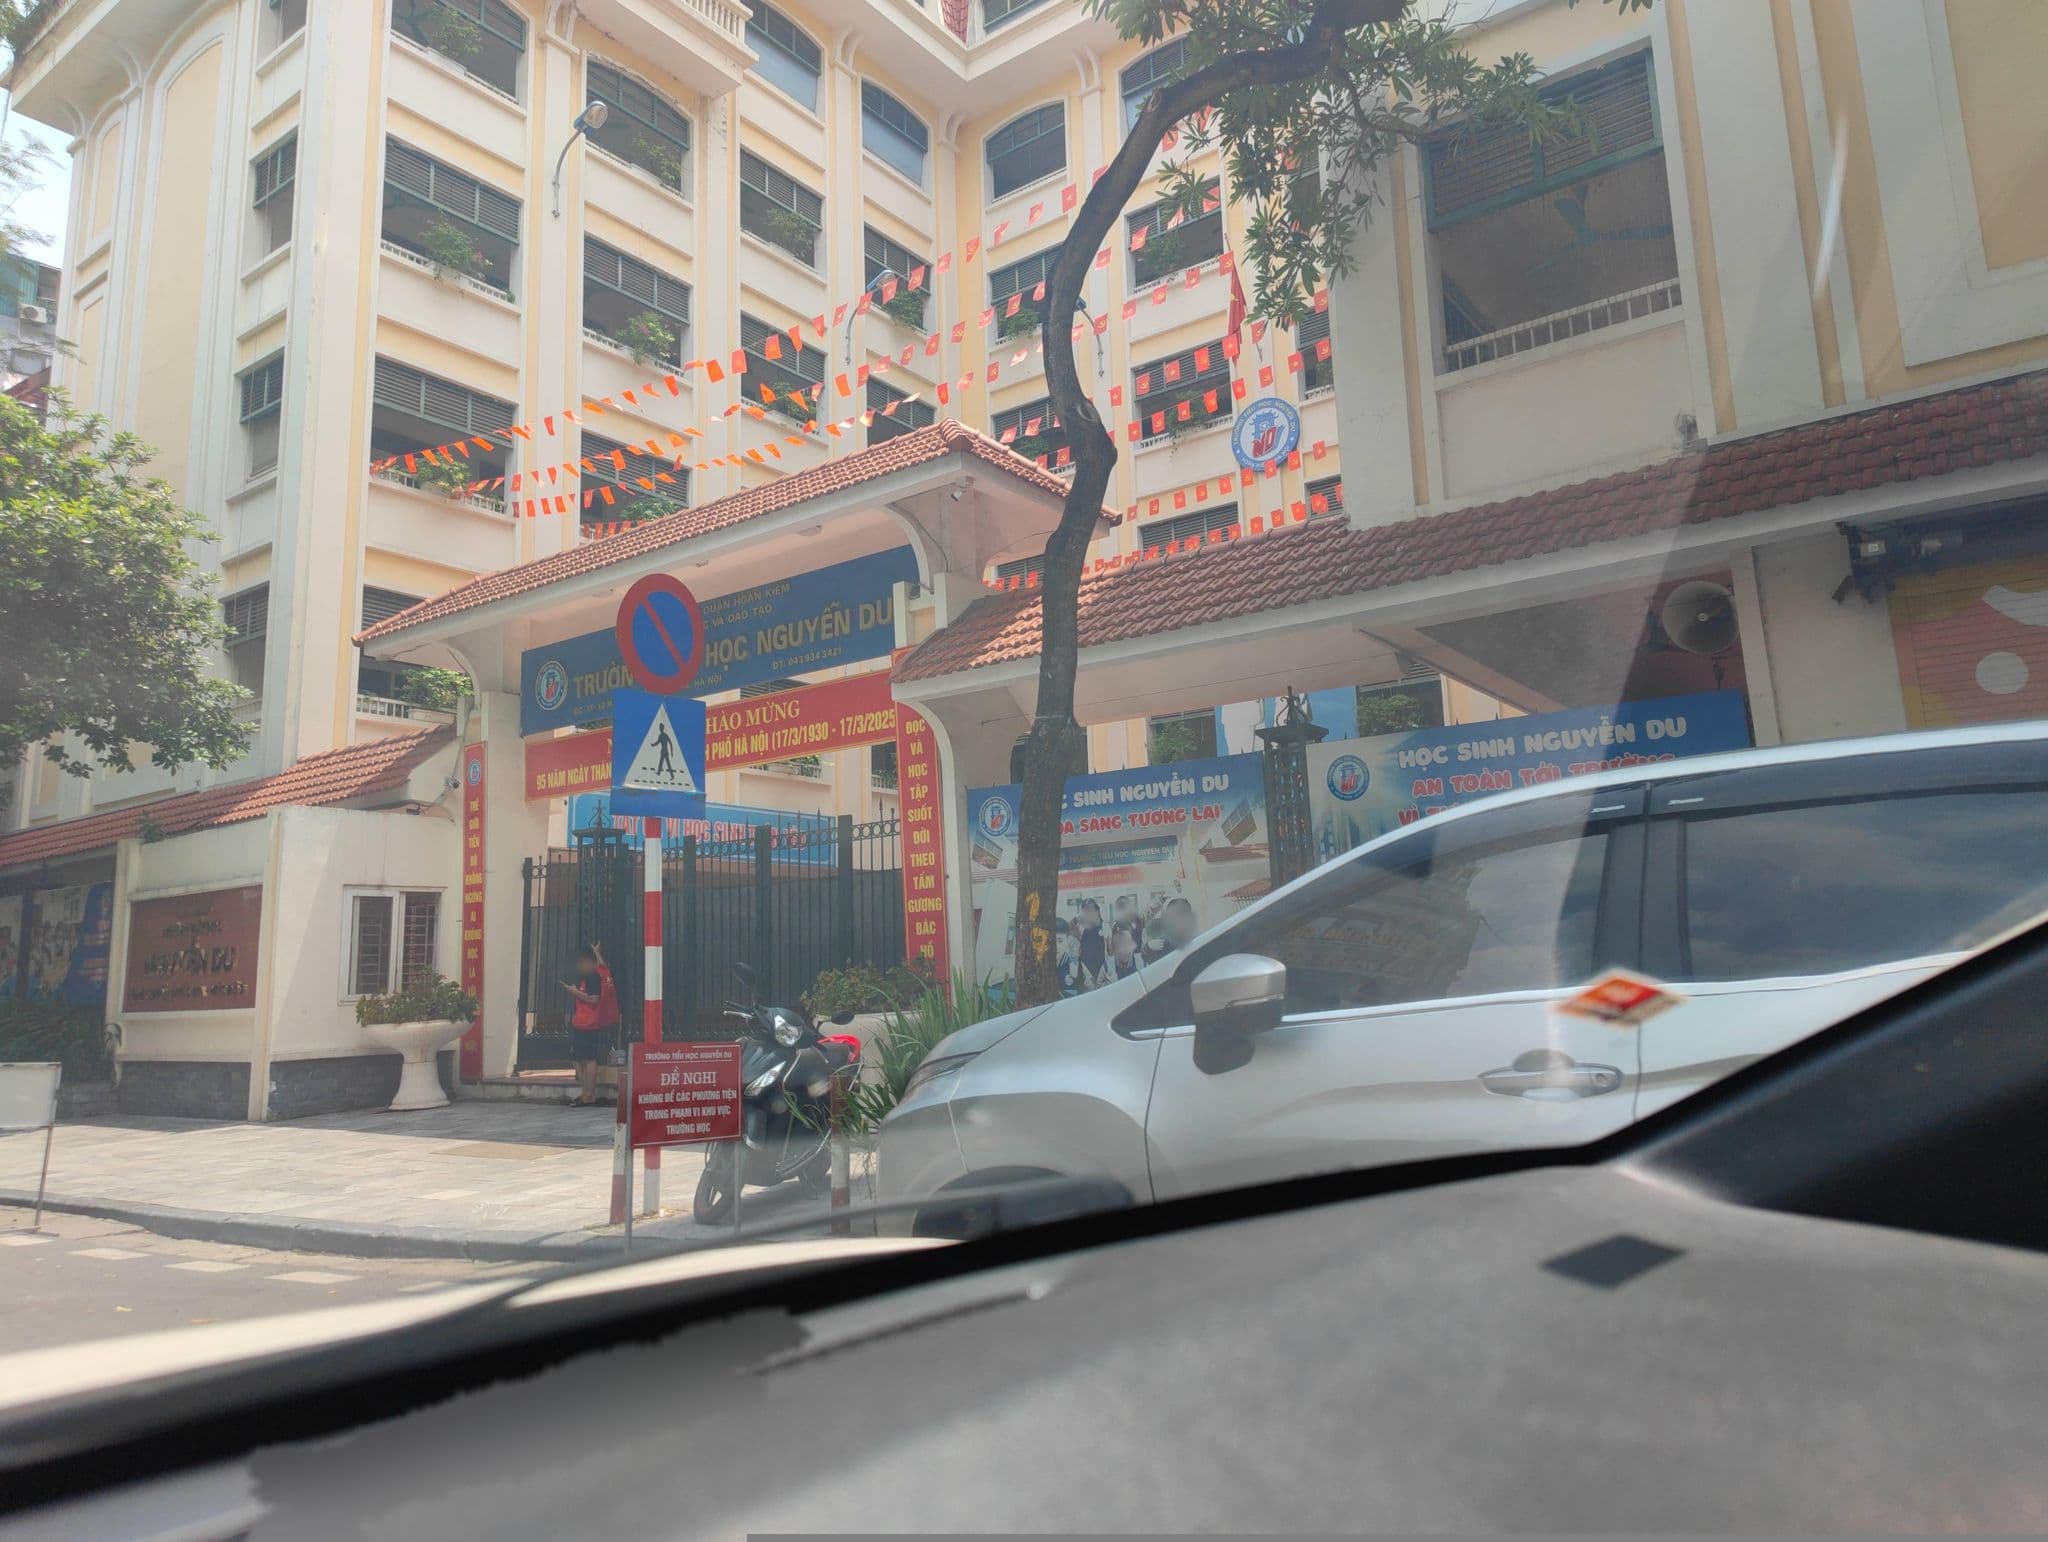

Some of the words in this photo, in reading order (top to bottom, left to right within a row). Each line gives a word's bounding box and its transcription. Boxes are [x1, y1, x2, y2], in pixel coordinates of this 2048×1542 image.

[574, 662, 634, 699] TRƯỜN
[705, 634, 748, 672] HỌC
[757, 600, 850, 655] NGUYỄN
[859, 597, 893, 631] DU
[706, 708, 741, 735] HÀO
[746, 699, 800, 727] MỪNG
[905, 718, 926, 735] ĐỌC
[712, 732, 731, 760] PHỐ
[734, 731, 749, 756] HÀ
[751, 728, 769, 757] NỘI
[772, 721, 829, 751] (17/3/1930
[1398, 745, 1449, 771] HỌC
[1457, 737, 1516, 761] SINH
[1524, 715, 1637, 754] NGUYỄN
[1646, 717, 1688, 740] DU
[548, 768, 566, 789] NĂM
[591, 759, 612, 782] THÀN
[907, 761, 928, 780] HỌC
[1412, 778, 1444, 798] AN
[1450, 768, 1512, 794] TOÀN
[1519, 761, 1562, 788] TỚI
[909, 782, 928, 802] TẬP
[1074, 788, 1114, 809] SINH
[1120, 771, 1196, 802] NGUYỄN
[1202, 773, 1230, 793] DU
[907, 802, 932, 823] SUỐT
[1127, 806, 1188, 829] TƯƠNG
[1191, 803, 1224, 822] LAI
[912, 827, 930, 844] ĐỜI
[910, 852, 935, 867] THEO
[907, 896, 942, 913] GƯƠNG
[915, 918, 936, 936] BÁC
[660, 1065, 680, 1086] ĐỀ
[682, 1071, 717, 1087] NGHỊ
[638, 1093, 664, 1105] KHÔNG
[676, 1091, 691, 1102] CÁC
[721, 1088, 737, 1101] TIỆN
[644, 1109, 669, 1120] TRONG
[670, 1107, 692, 1120] PHẠM
[692, 1107, 700, 1117] VI
[701, 1106, 716, 1117] KHU
[717, 1105, 731, 1117] VỰC
[666, 1121, 695, 1135] TRƯỜNG
[696, 1123, 711, 1134] HỌC
